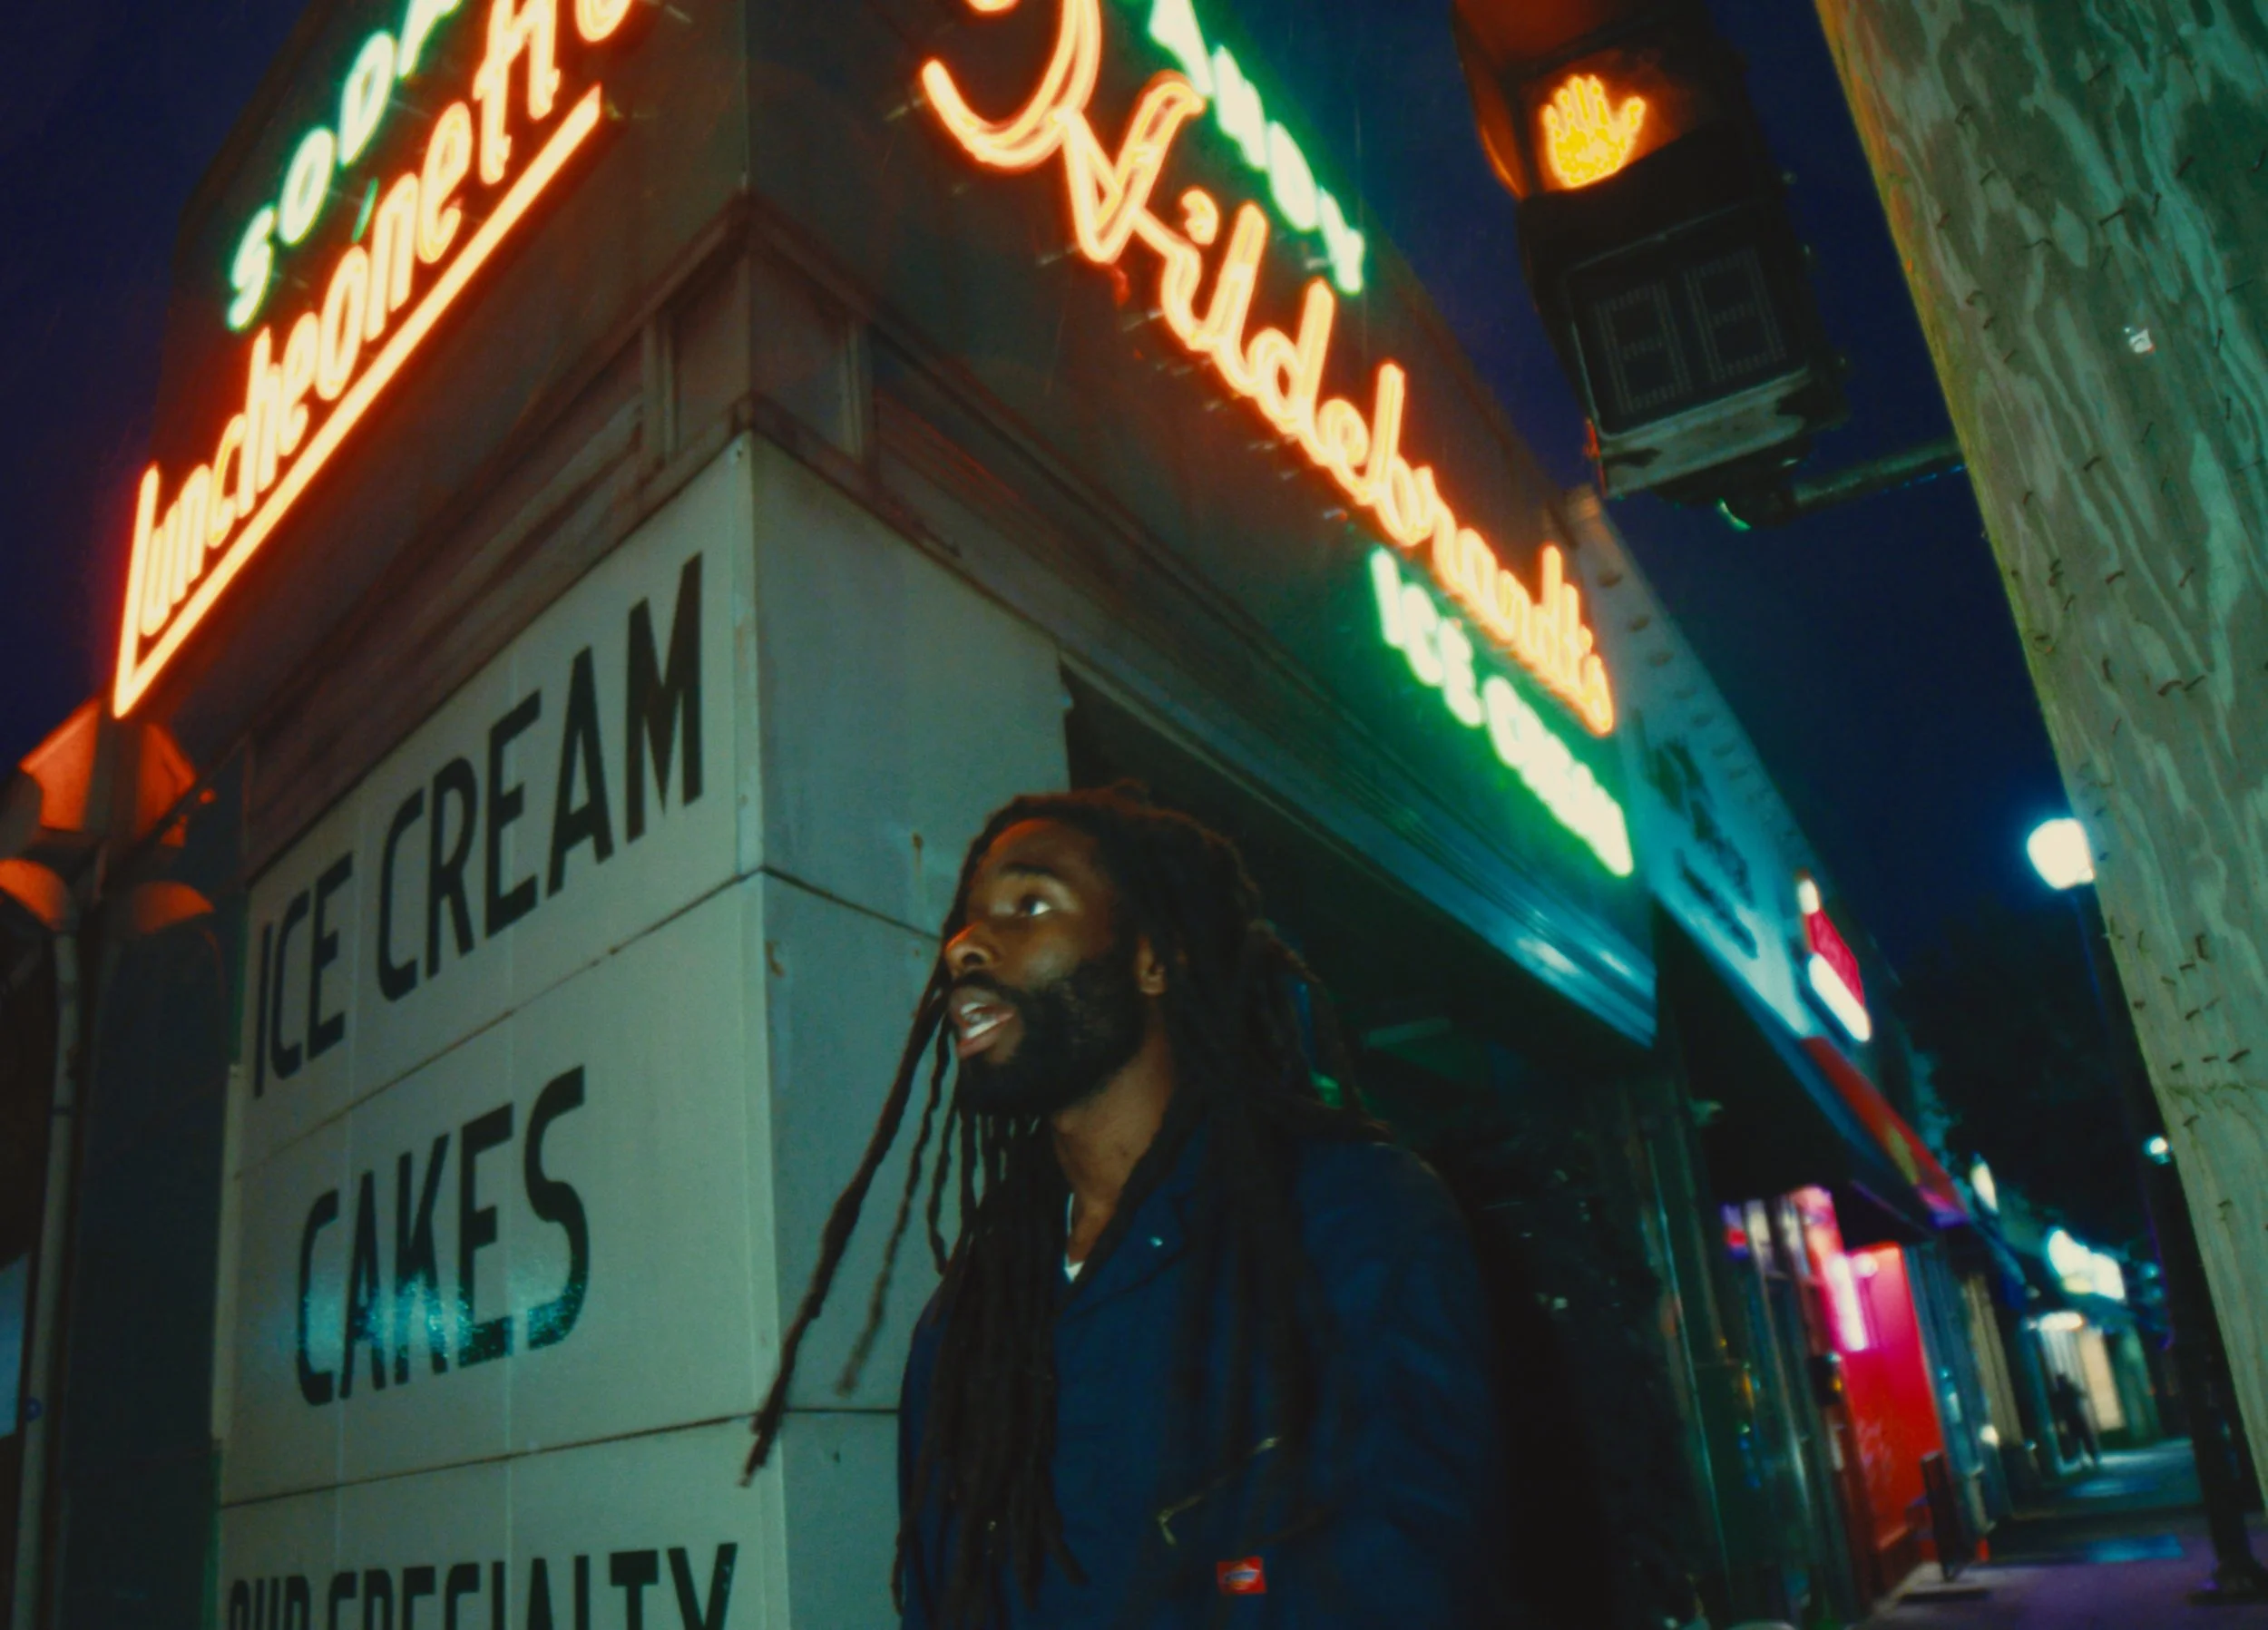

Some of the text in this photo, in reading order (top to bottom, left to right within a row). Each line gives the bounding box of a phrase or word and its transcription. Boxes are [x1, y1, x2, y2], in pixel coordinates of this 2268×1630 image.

[256, 551, 703, 1098] ICE CREAM
[297, 1065, 590, 1406] CAKES
